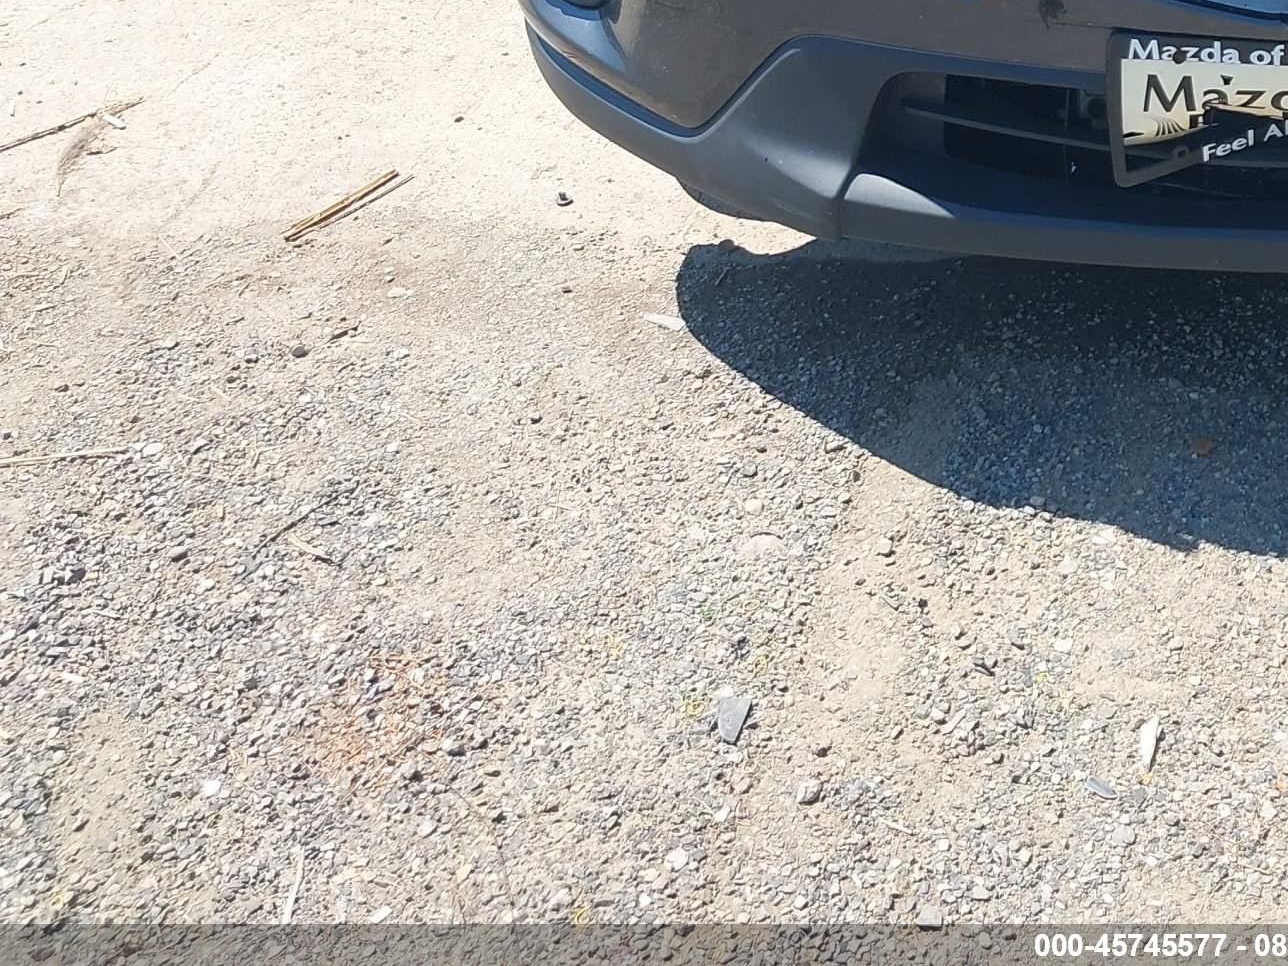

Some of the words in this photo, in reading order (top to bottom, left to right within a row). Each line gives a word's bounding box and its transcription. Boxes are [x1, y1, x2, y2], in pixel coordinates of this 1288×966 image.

[1128, 38, 1241, 64] Mazda
[1250, 44, 1285, 66] of
[1202, 129, 1255, 163] Feel
